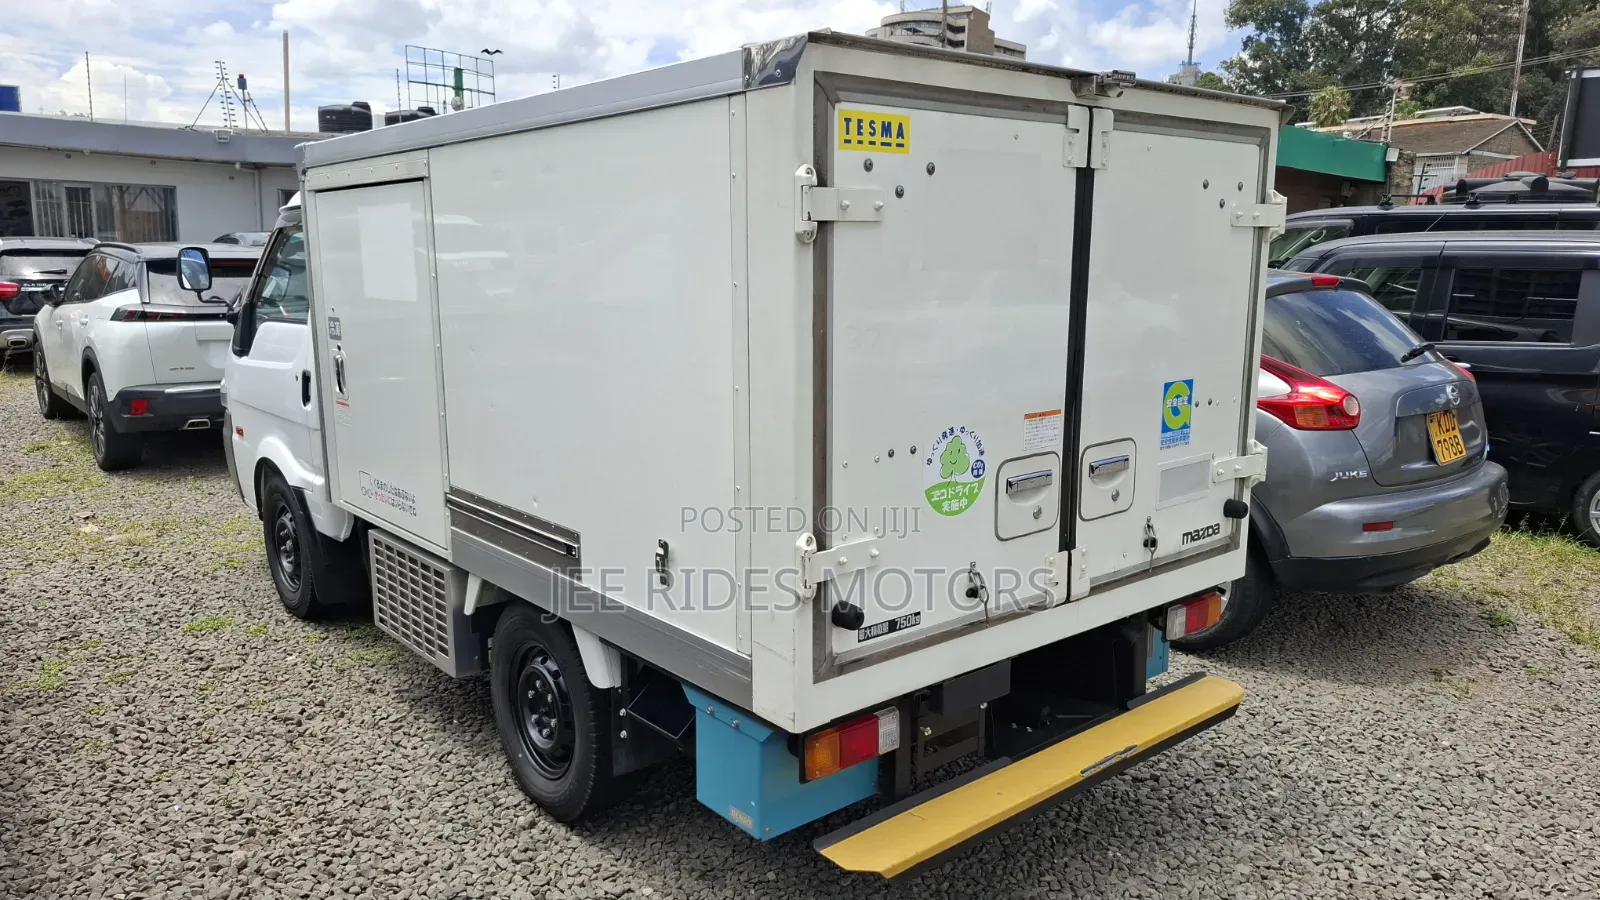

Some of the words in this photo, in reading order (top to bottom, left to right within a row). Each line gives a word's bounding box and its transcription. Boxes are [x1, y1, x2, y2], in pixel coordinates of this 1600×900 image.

[843, 117, 905, 140] TESMA
[1436, 434, 1464, 461] 798B
[1329, 470, 1368, 482] JUKE
[941, 496, 969, 513] 実施中
[894, 613, 921, 630] 750kg
